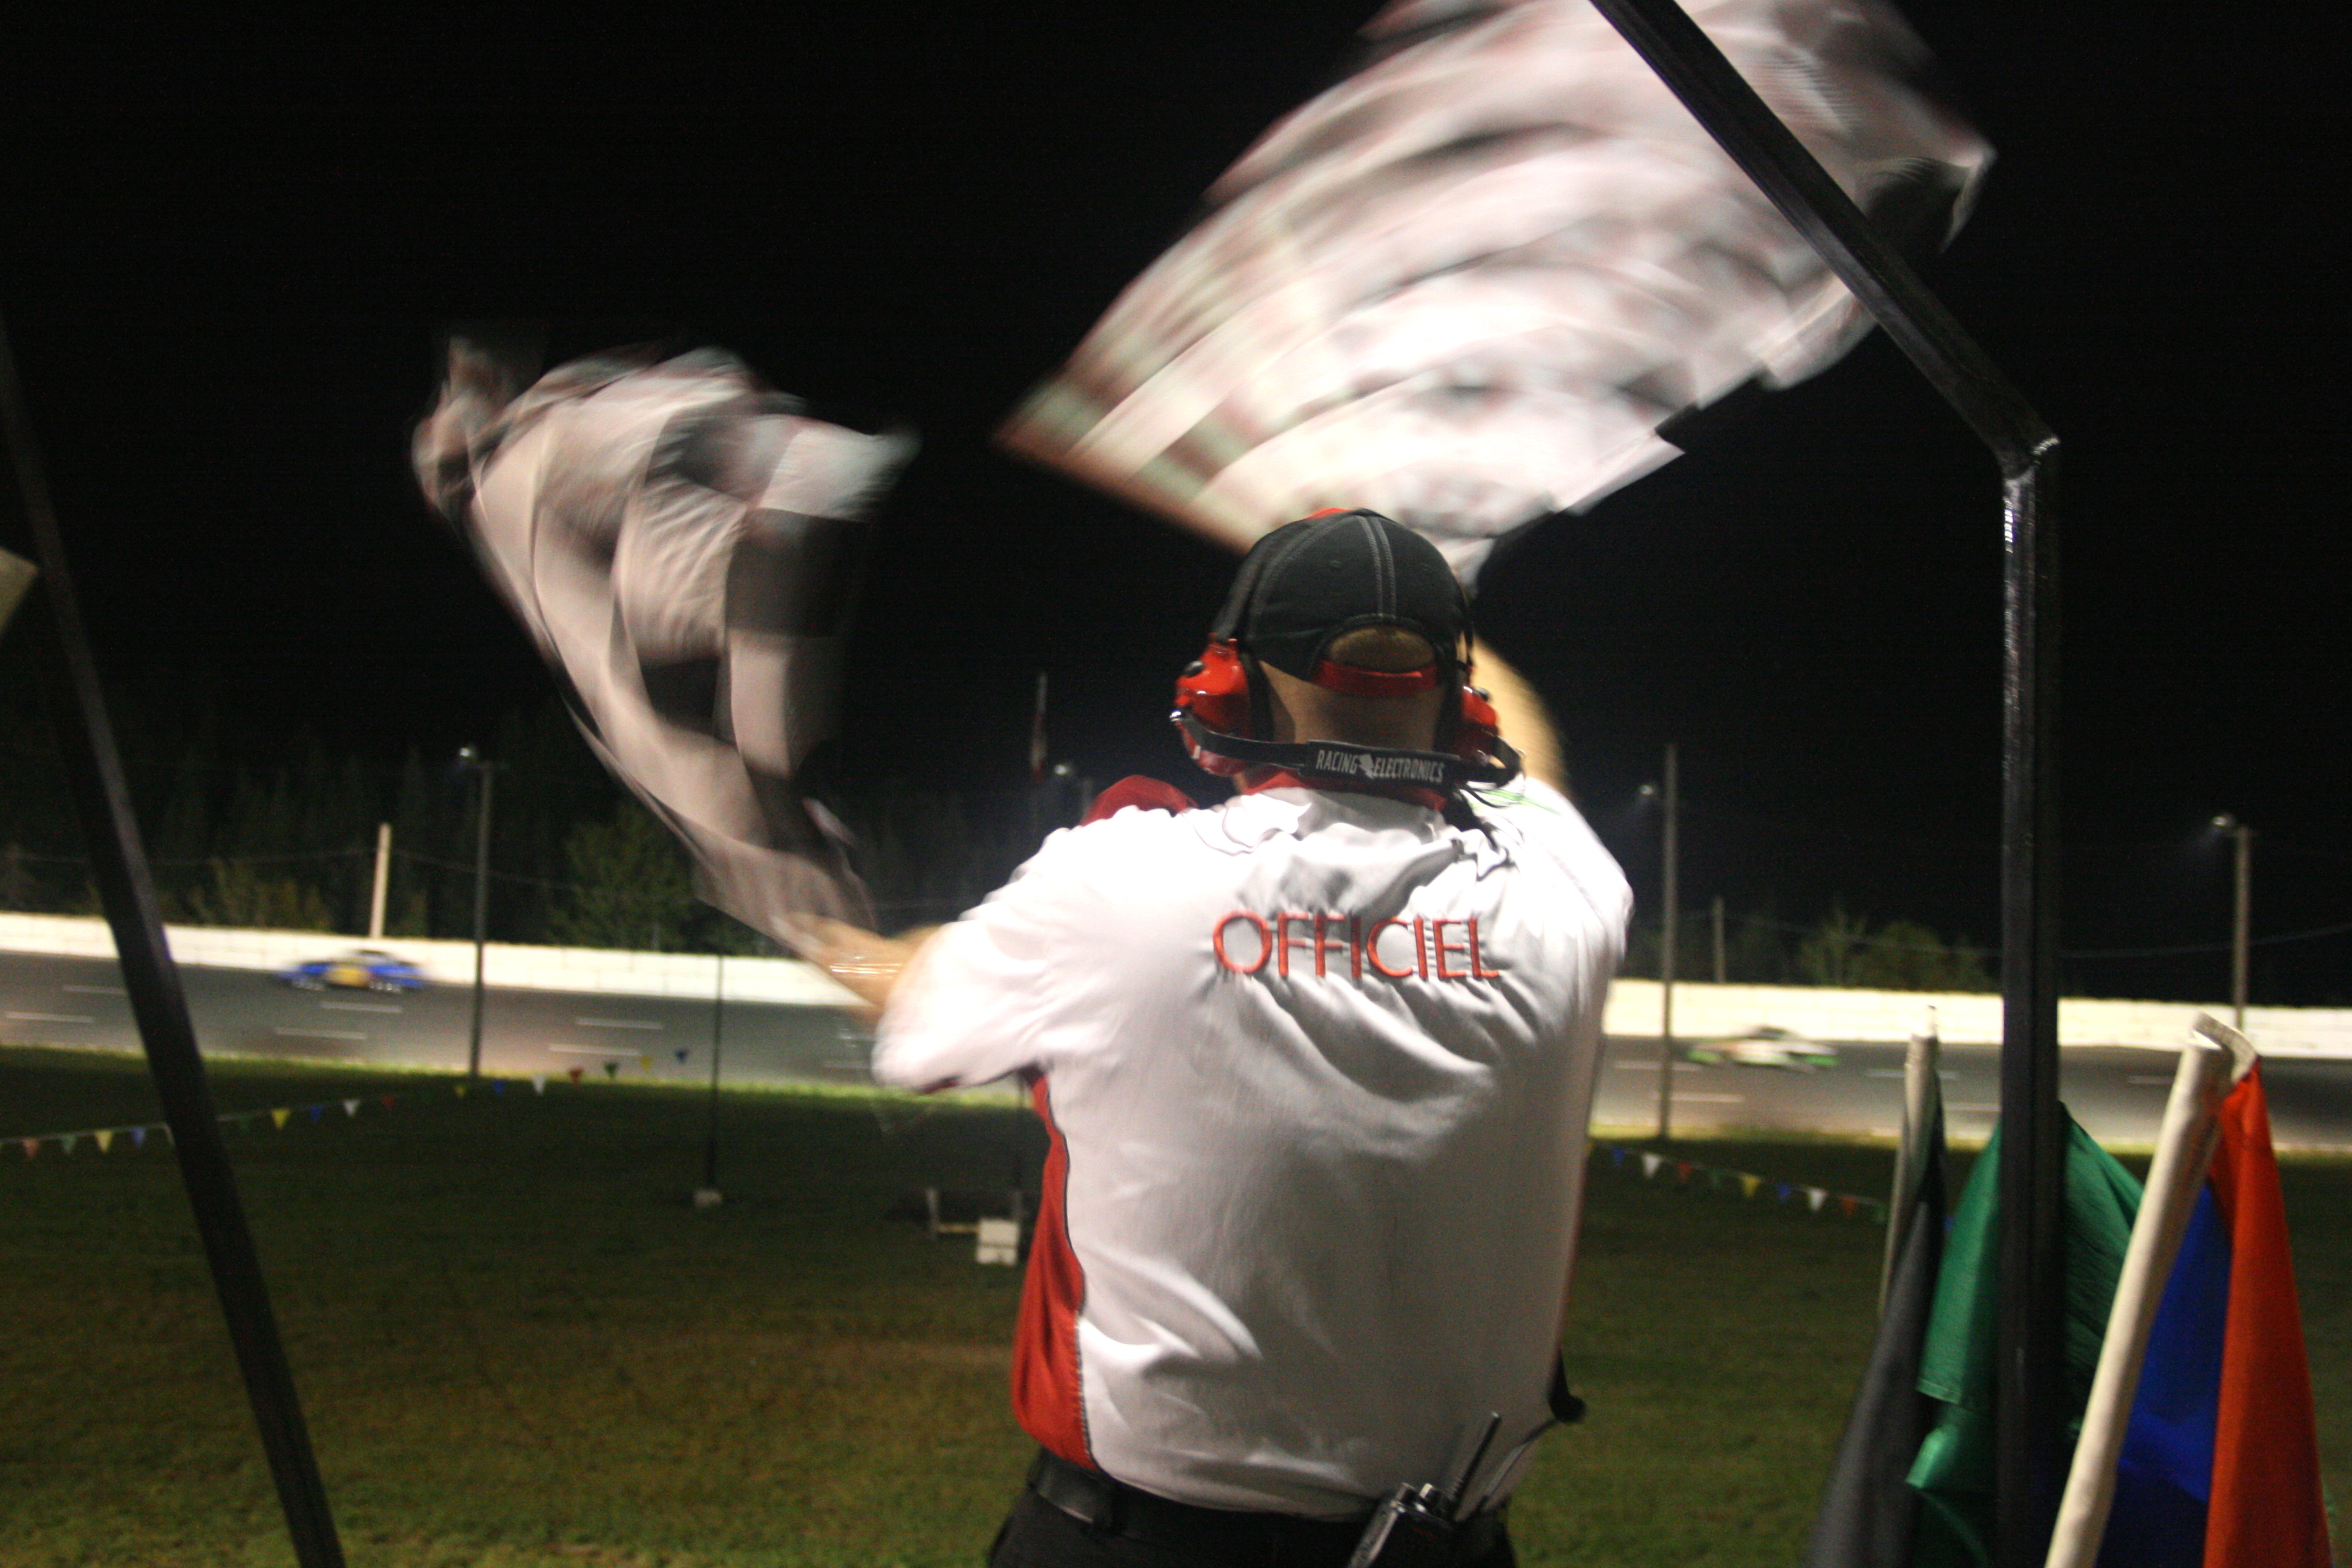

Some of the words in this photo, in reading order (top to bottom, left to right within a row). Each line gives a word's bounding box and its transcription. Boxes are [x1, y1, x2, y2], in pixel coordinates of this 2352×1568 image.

[1315, 750, 1360, 776] RACING
[1373, 757, 1445, 783] ELECTRONICS
[1212, 909, 1500, 980] OFFICIEL
